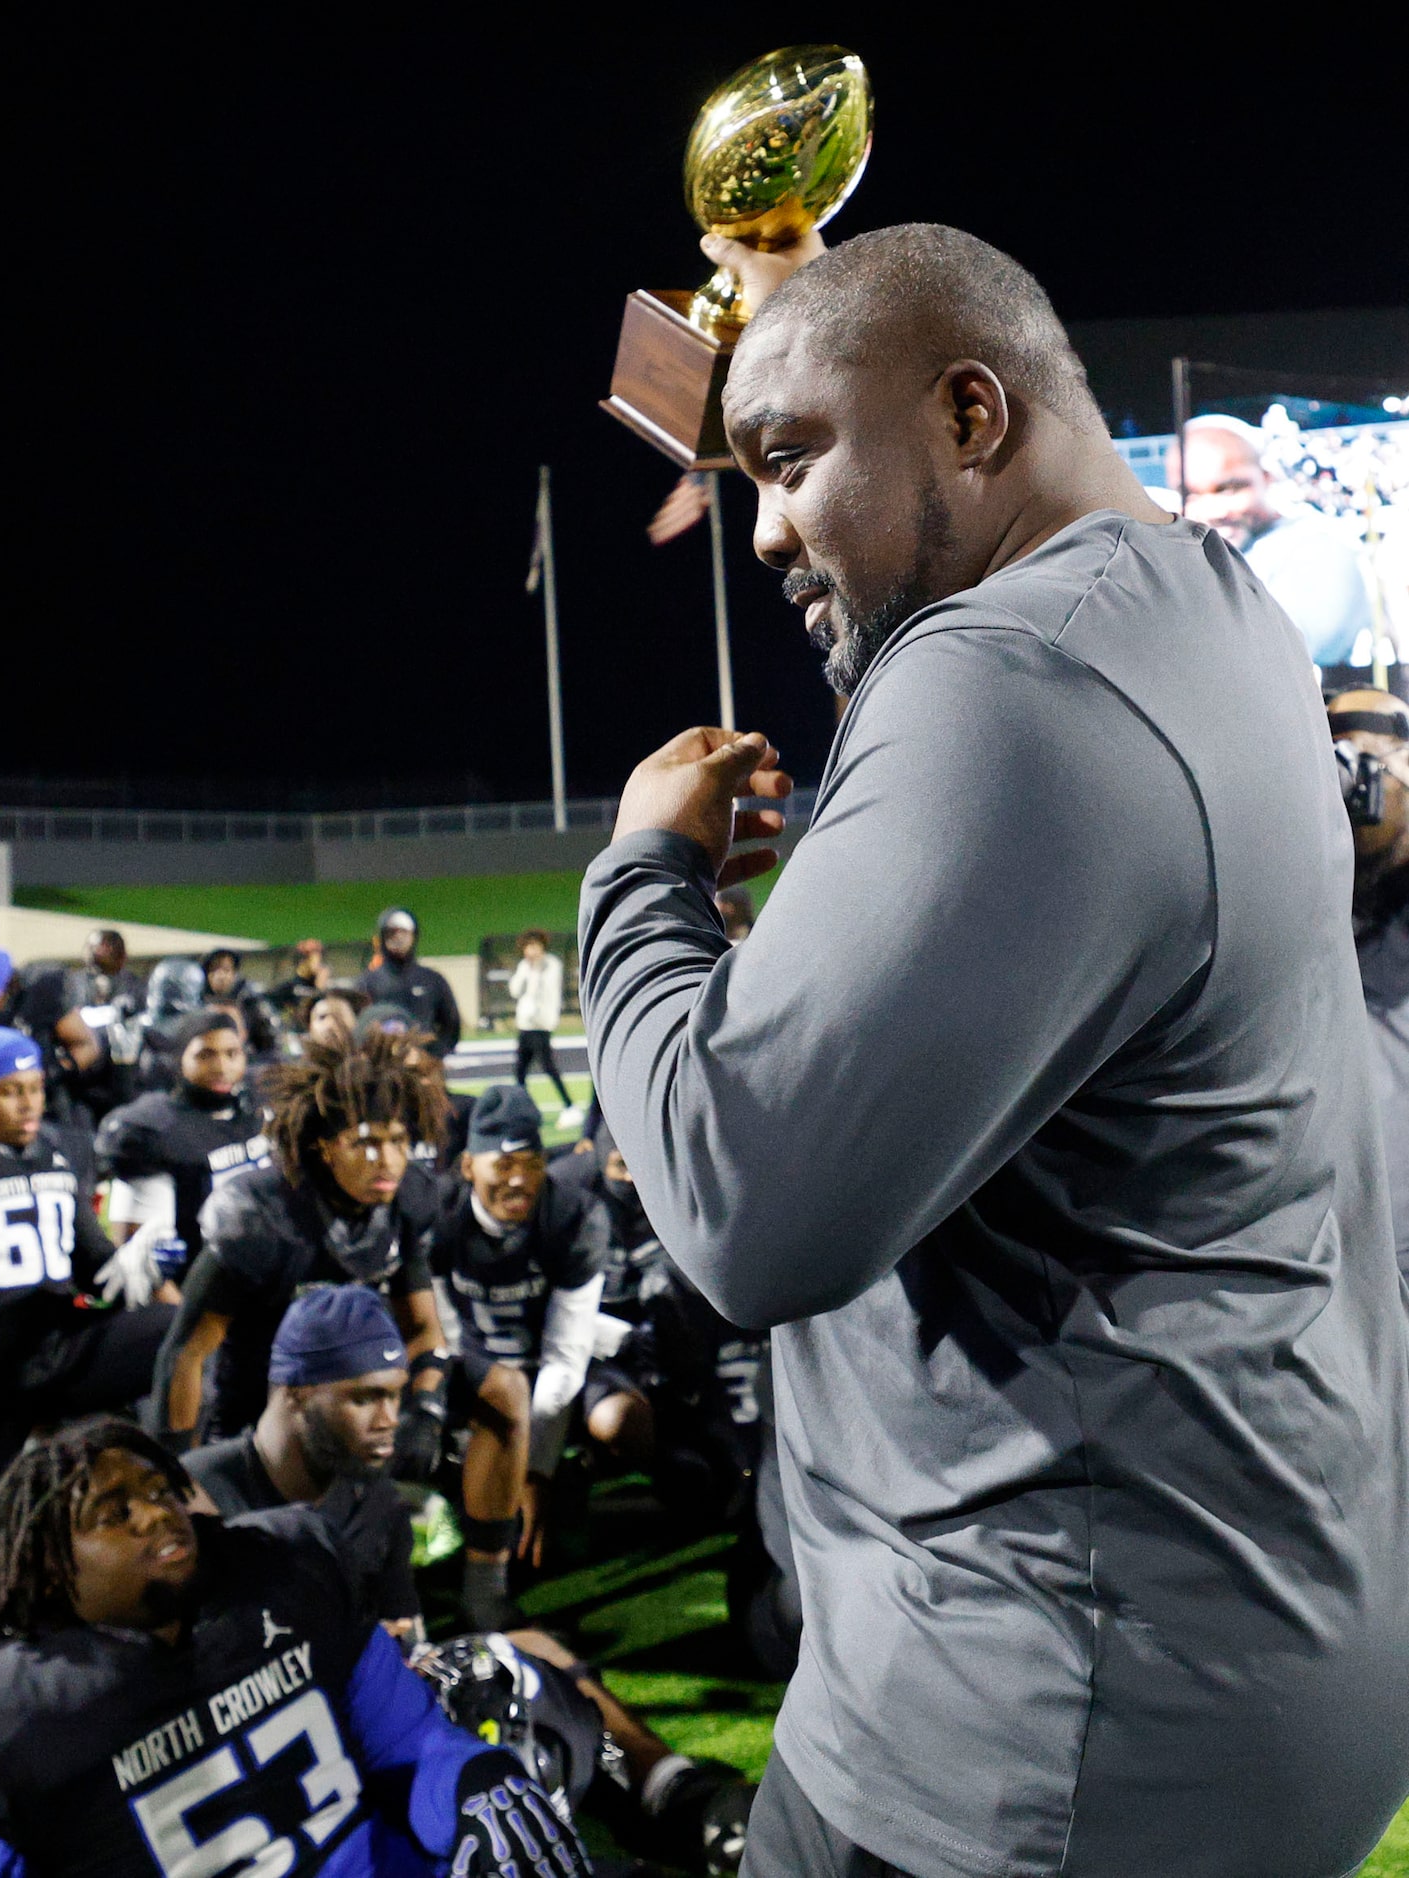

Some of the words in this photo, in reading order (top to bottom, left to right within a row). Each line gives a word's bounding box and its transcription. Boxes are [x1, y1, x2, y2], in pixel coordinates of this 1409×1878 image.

[111, 1709, 204, 1791] NORTH
[208, 1640, 313, 1736] CROWLEY
[129, 1688, 362, 1878] 53
